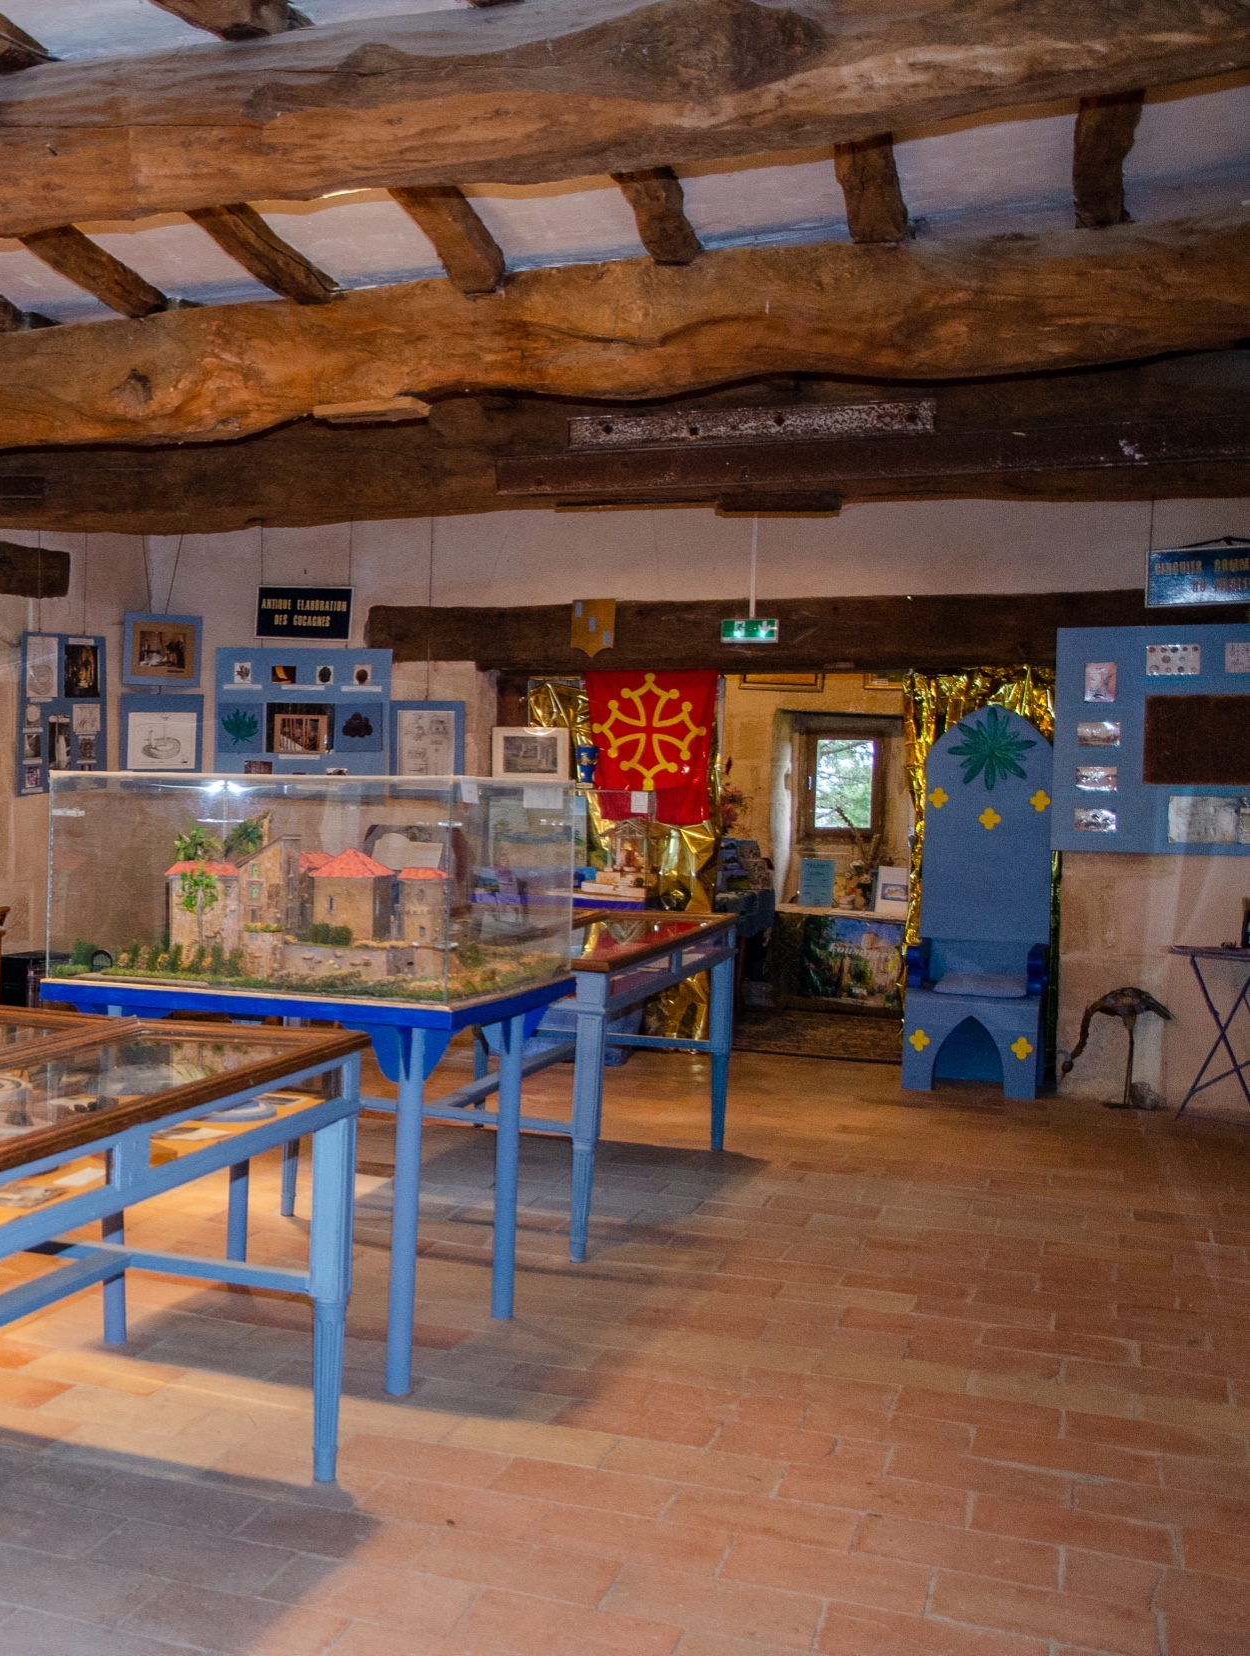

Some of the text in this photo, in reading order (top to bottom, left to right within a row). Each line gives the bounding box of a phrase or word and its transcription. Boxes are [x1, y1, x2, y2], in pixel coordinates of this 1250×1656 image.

[1214, 577, 1250, 591] PASTE
[261, 599, 347, 611] ANTIQUE ELABORATION
[274, 615, 331, 627] DES COCAGNES
